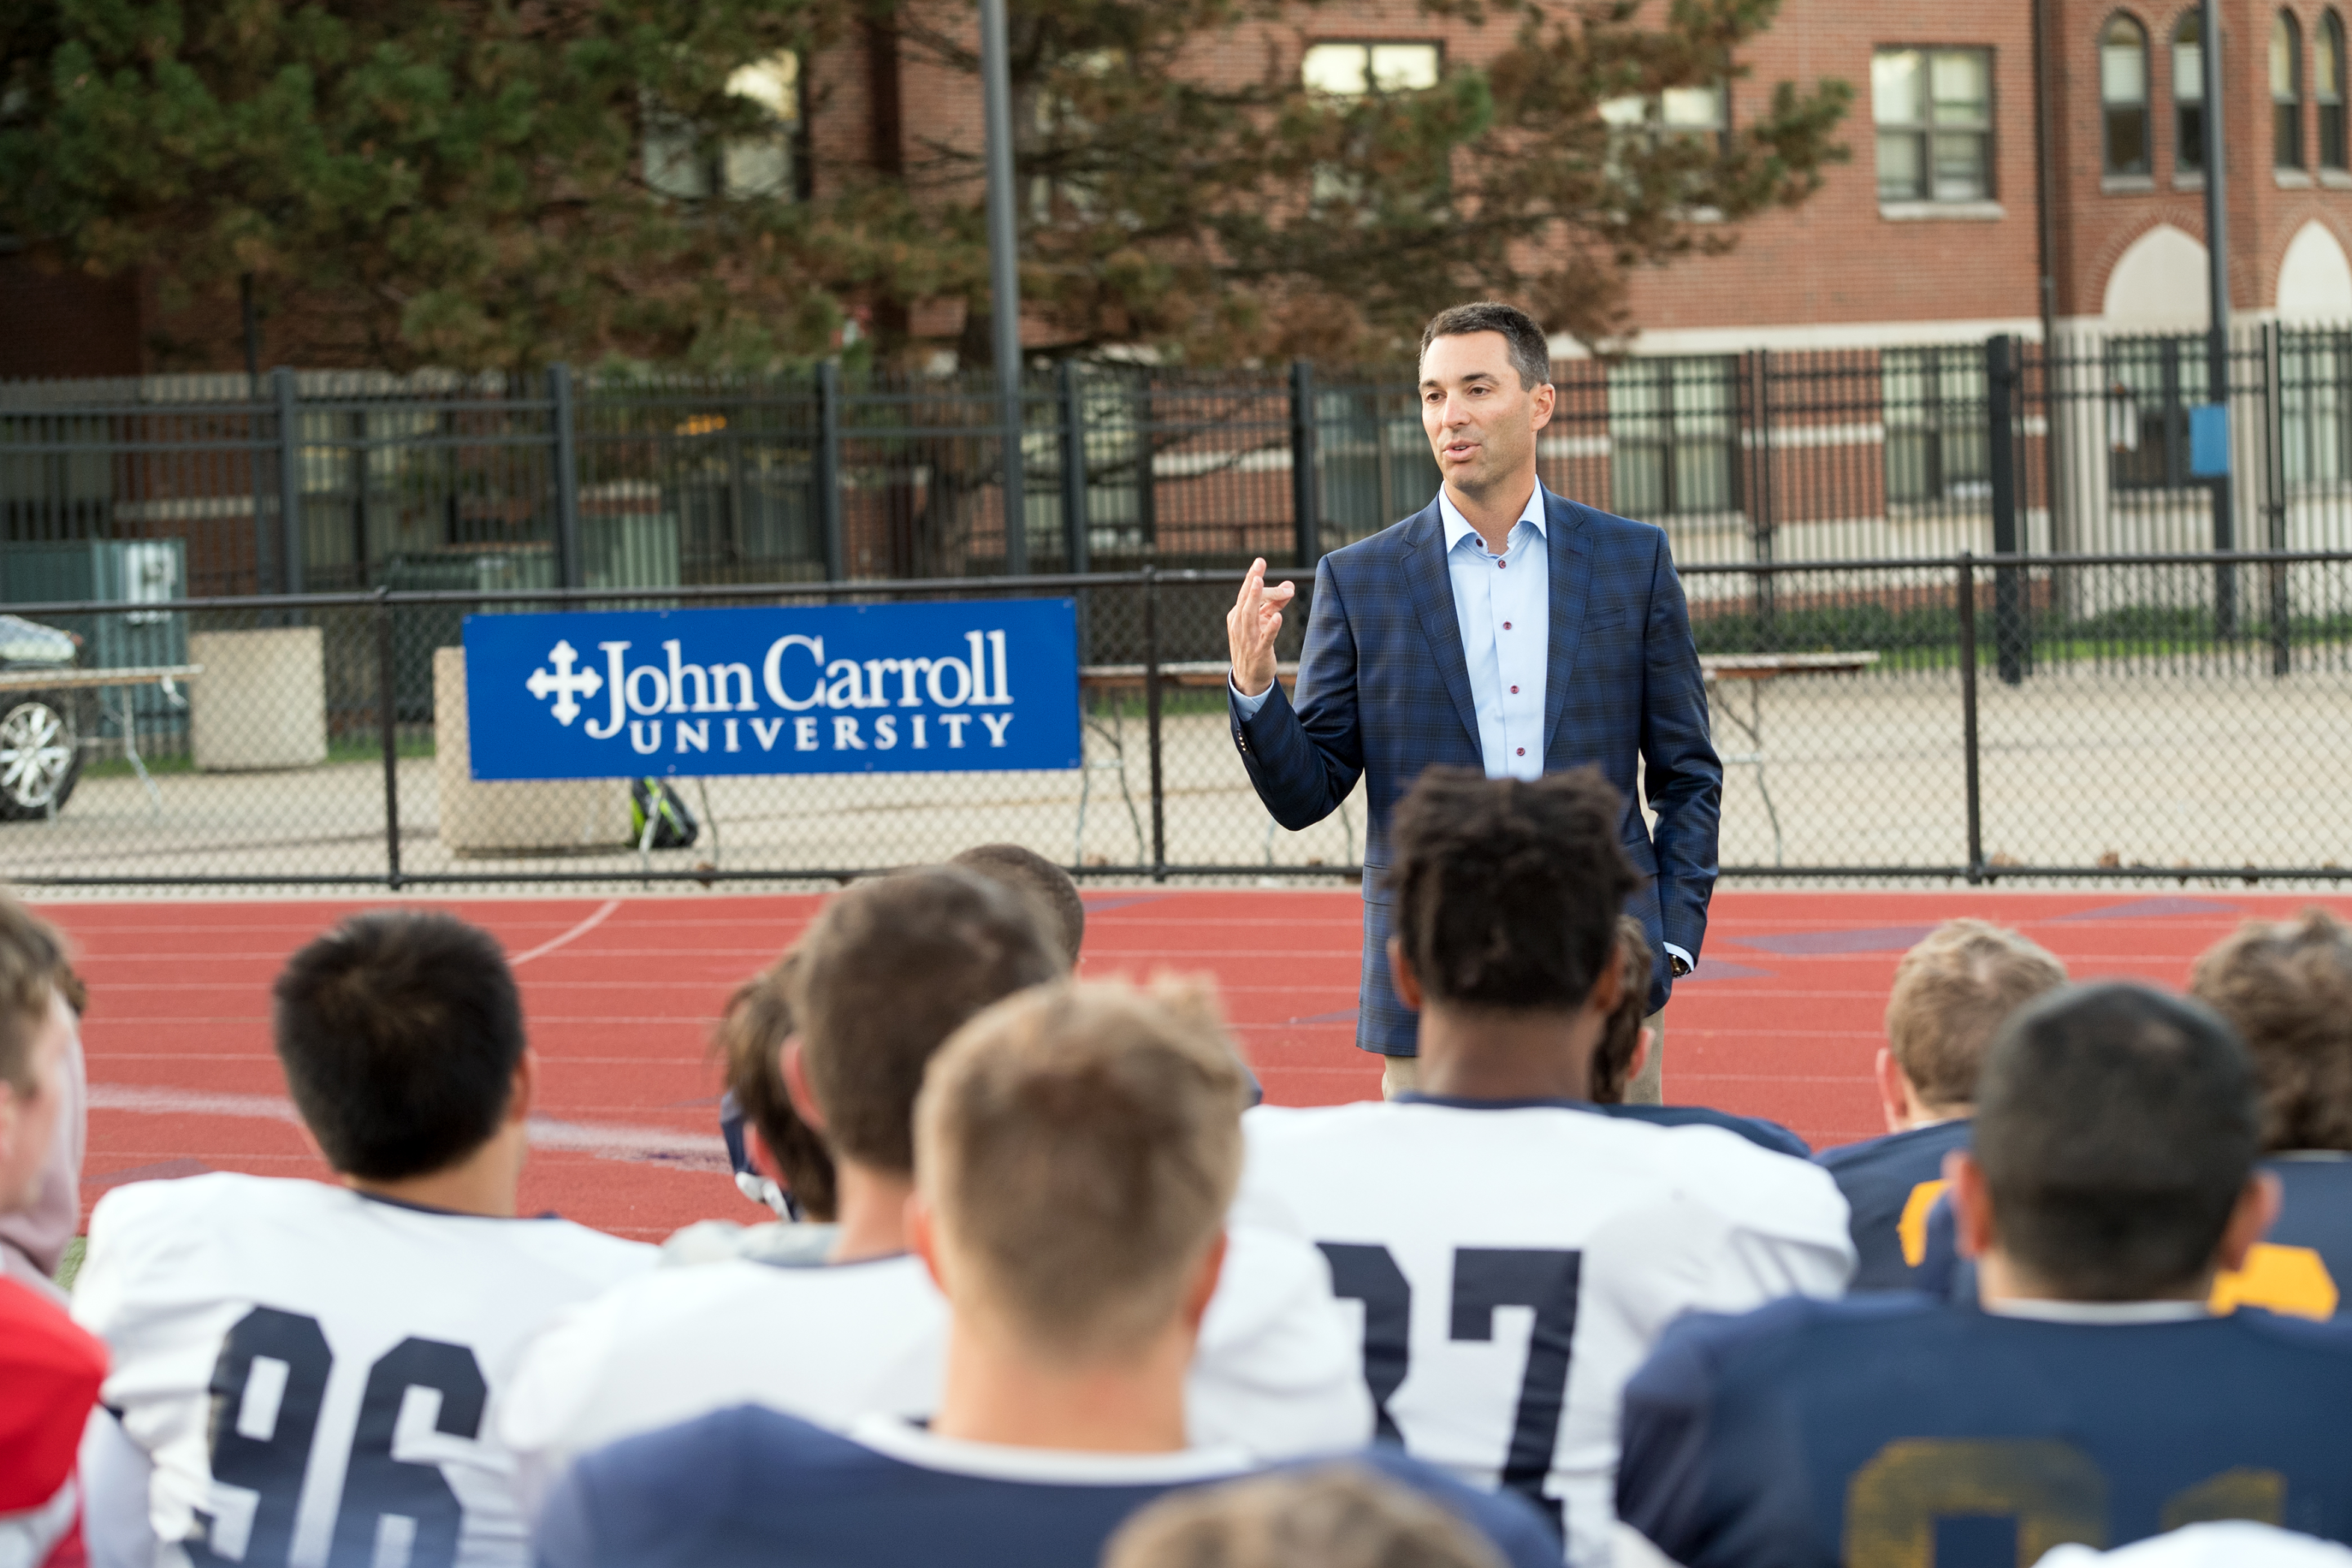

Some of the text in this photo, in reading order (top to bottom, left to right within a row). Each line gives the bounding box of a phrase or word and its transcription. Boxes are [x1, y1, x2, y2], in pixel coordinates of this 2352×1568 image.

[585, 629, 1013, 738] John Carroll
[630, 712, 1013, 755] UNIVERSITY
[182, 1305, 489, 1567] 96
